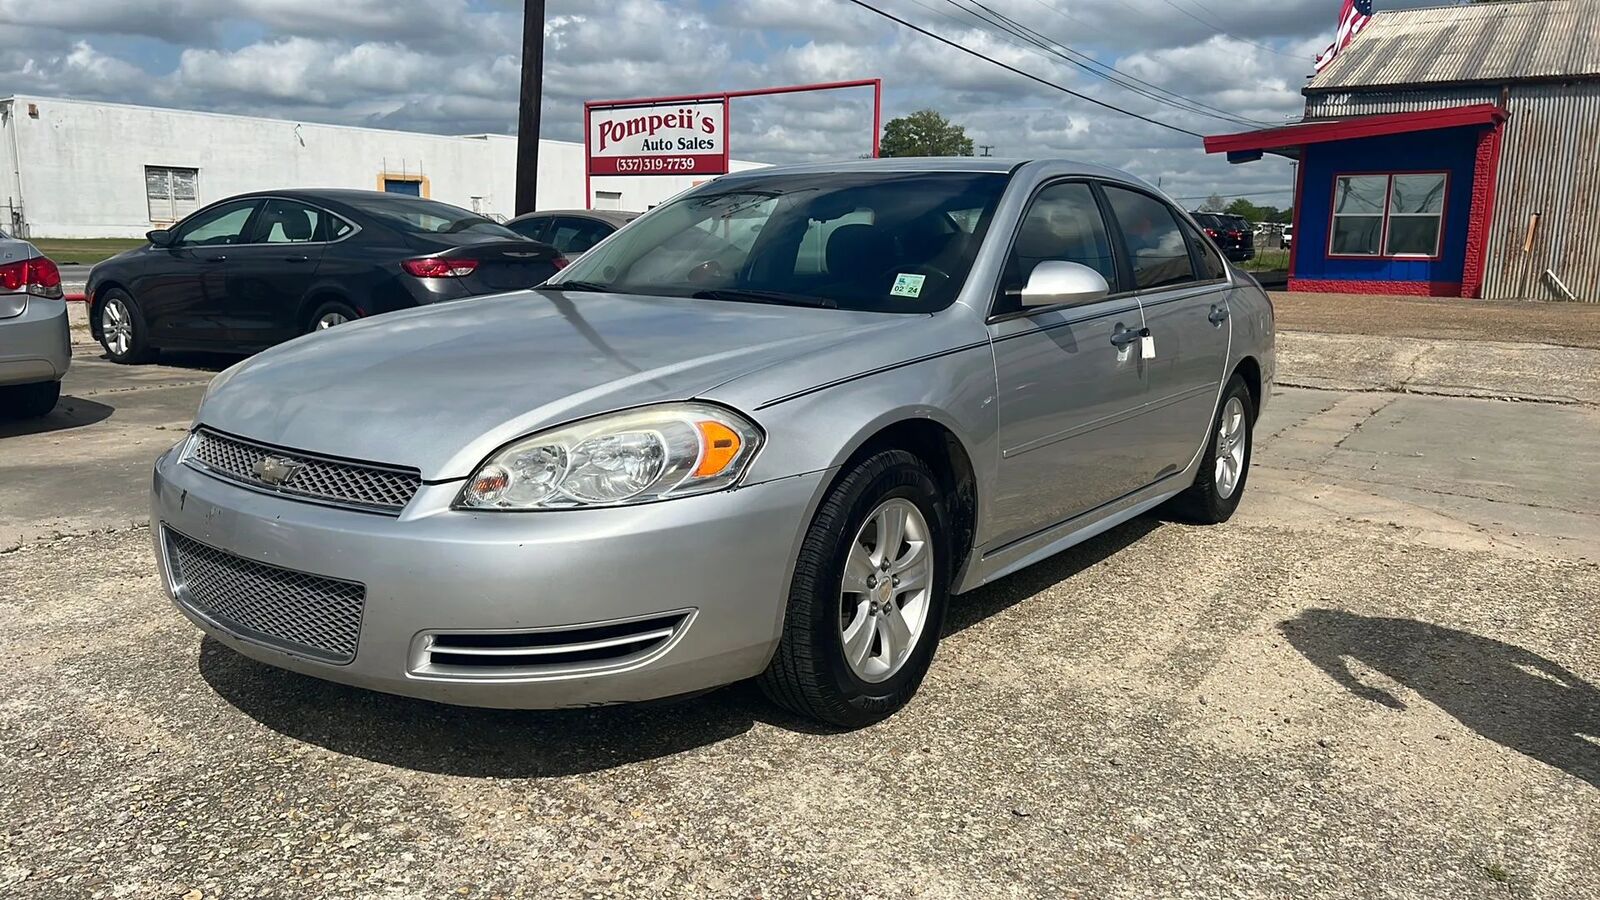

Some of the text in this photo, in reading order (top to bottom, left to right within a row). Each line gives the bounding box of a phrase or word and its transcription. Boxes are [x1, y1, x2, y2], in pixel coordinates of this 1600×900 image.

[598, 108, 715, 152] Pompeii's
[641, 137, 714, 151] Auto Sales
